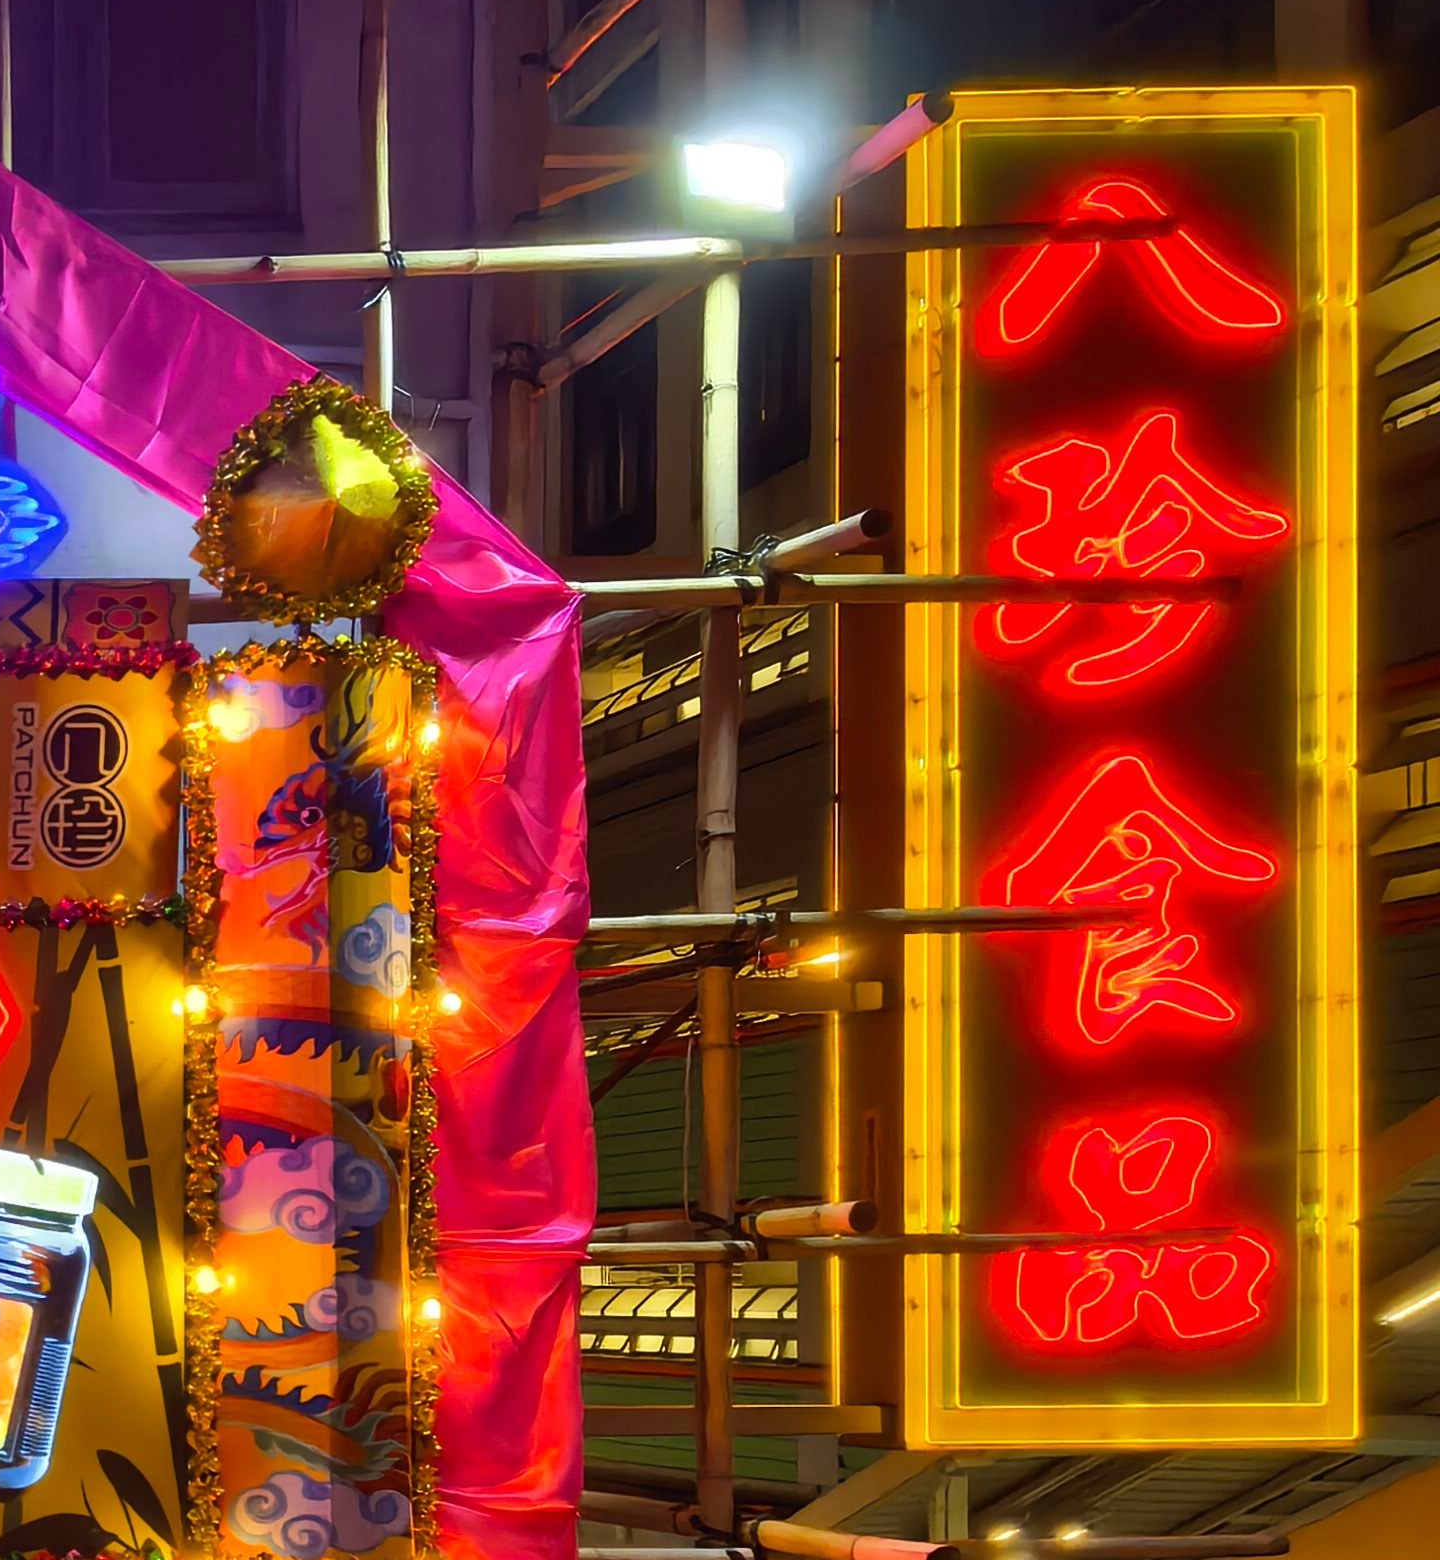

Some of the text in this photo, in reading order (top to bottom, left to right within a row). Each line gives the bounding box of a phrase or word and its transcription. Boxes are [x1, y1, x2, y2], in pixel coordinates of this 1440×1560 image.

[11, 707, 35, 866] PATCHUN
[978, 175, 1288, 1352] 八珍食品
